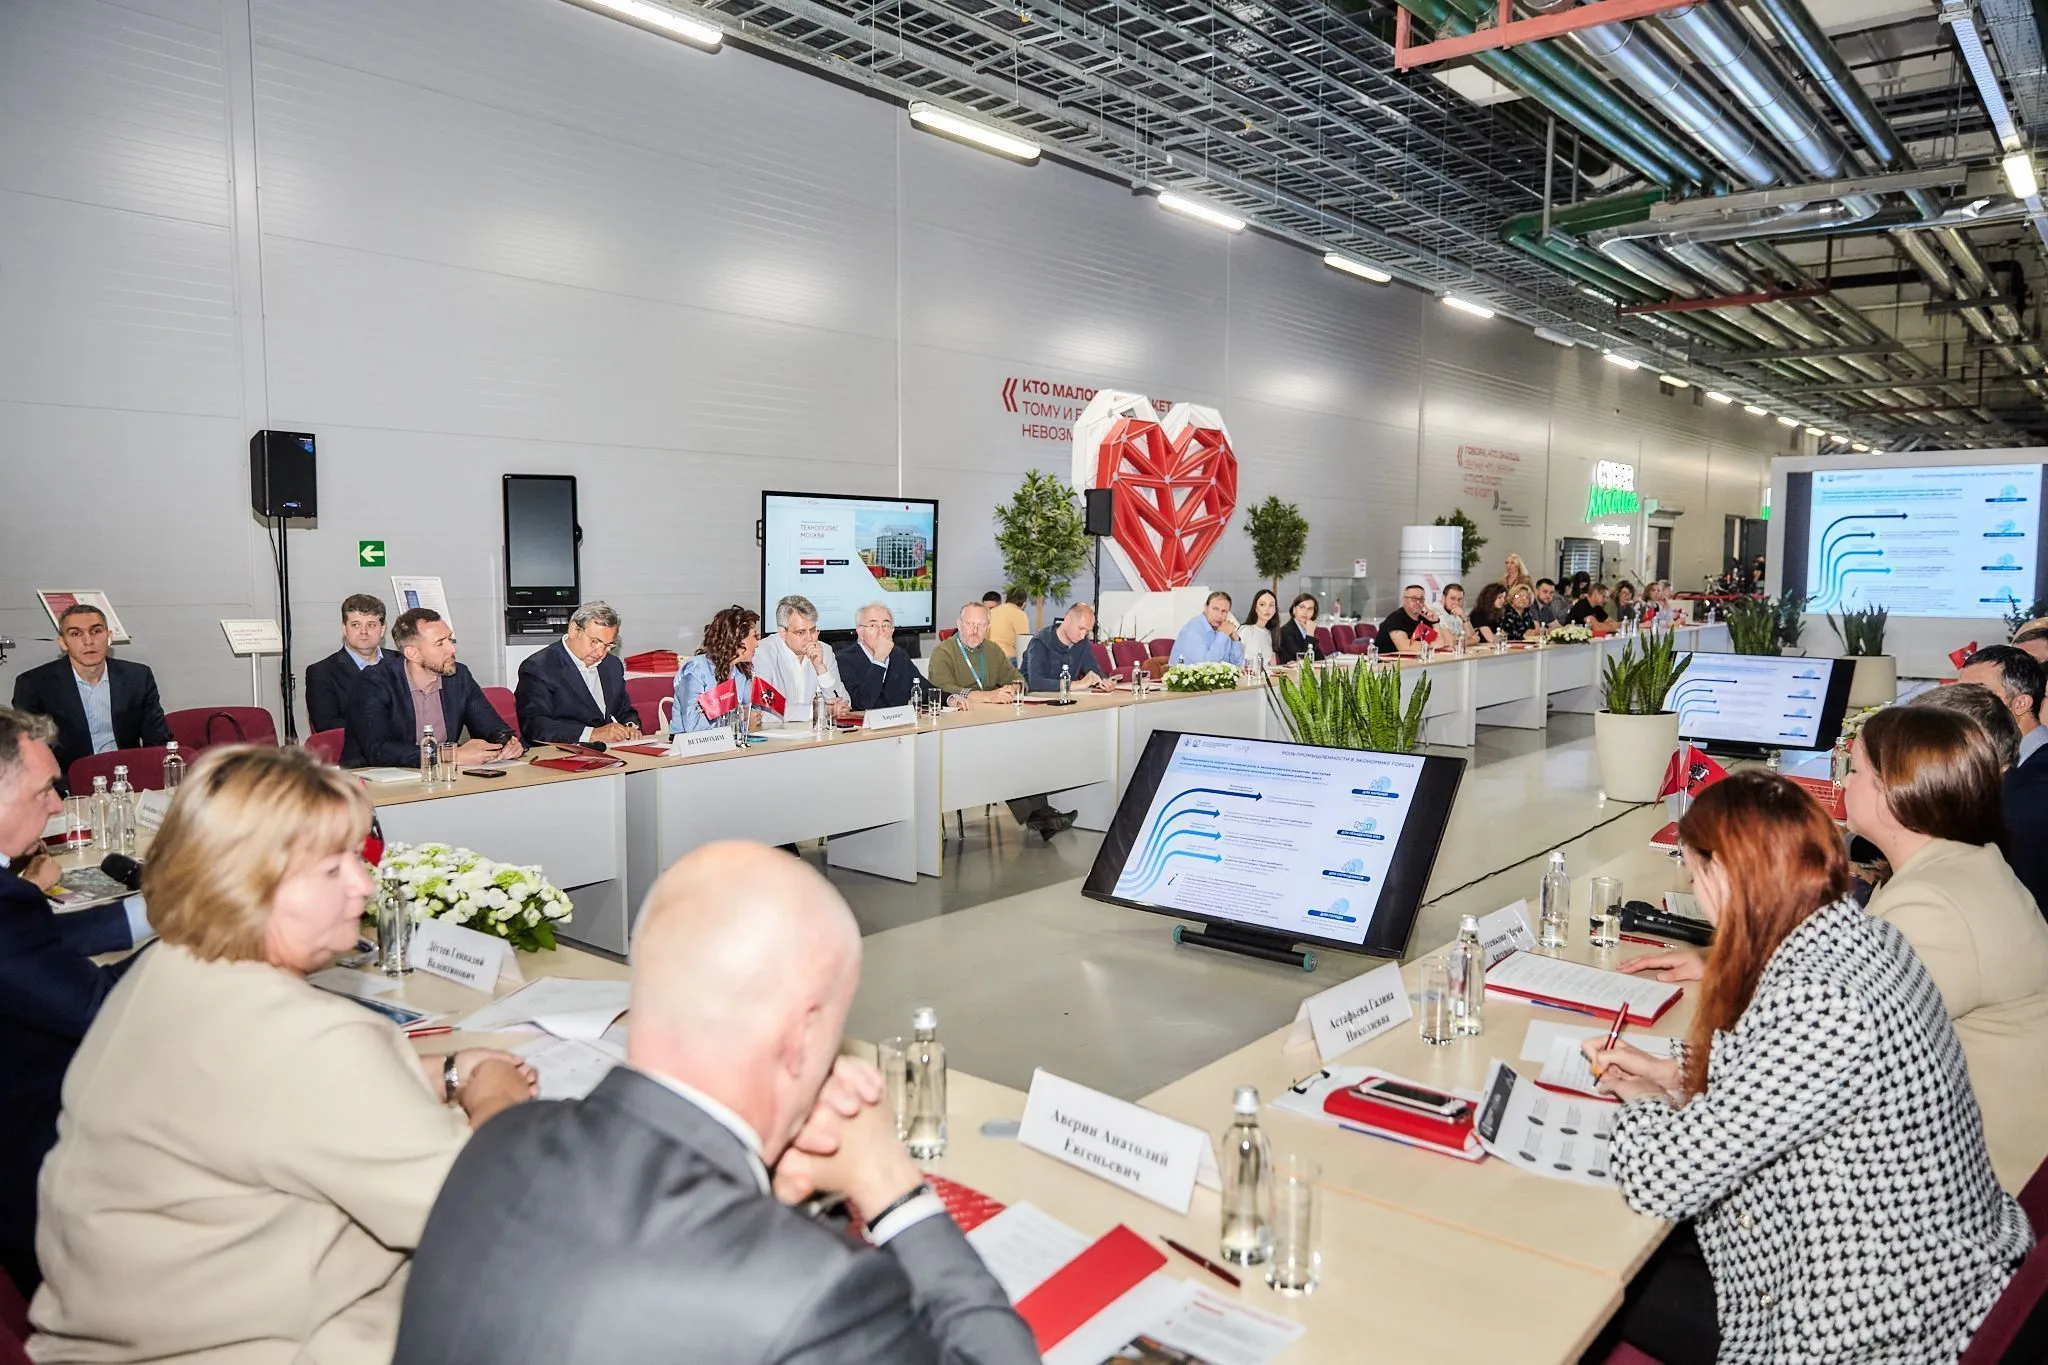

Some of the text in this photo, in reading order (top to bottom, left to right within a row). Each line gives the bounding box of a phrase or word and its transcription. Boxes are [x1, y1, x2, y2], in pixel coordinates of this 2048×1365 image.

[1022, 379, 1050, 395] КТО
[1053, 384, 1098, 402] МАЛО
[1022, 401, 1061, 418] ТОМУ
[1063, 407, 1073, 421] И
[1022, 424, 1073, 442] НЕВОЗМ
[1296, 752, 1350, 762] ПРОМЫШЛЕННОСТИ
[1355, 758, 1390, 766] ЭКОНОМИКЕ
[451, 947, 485, 966] Геннадий
[427, 957, 476, 980] Валентинович
[1328, 992, 1394, 1031] Астафьева Галина
[1346, 1014, 1390, 1042] Николаевна
[1050, 1108, 1169, 1167] Аверин Анатолий
[1064, 1137, 1142, 1182] Евгеньевич
